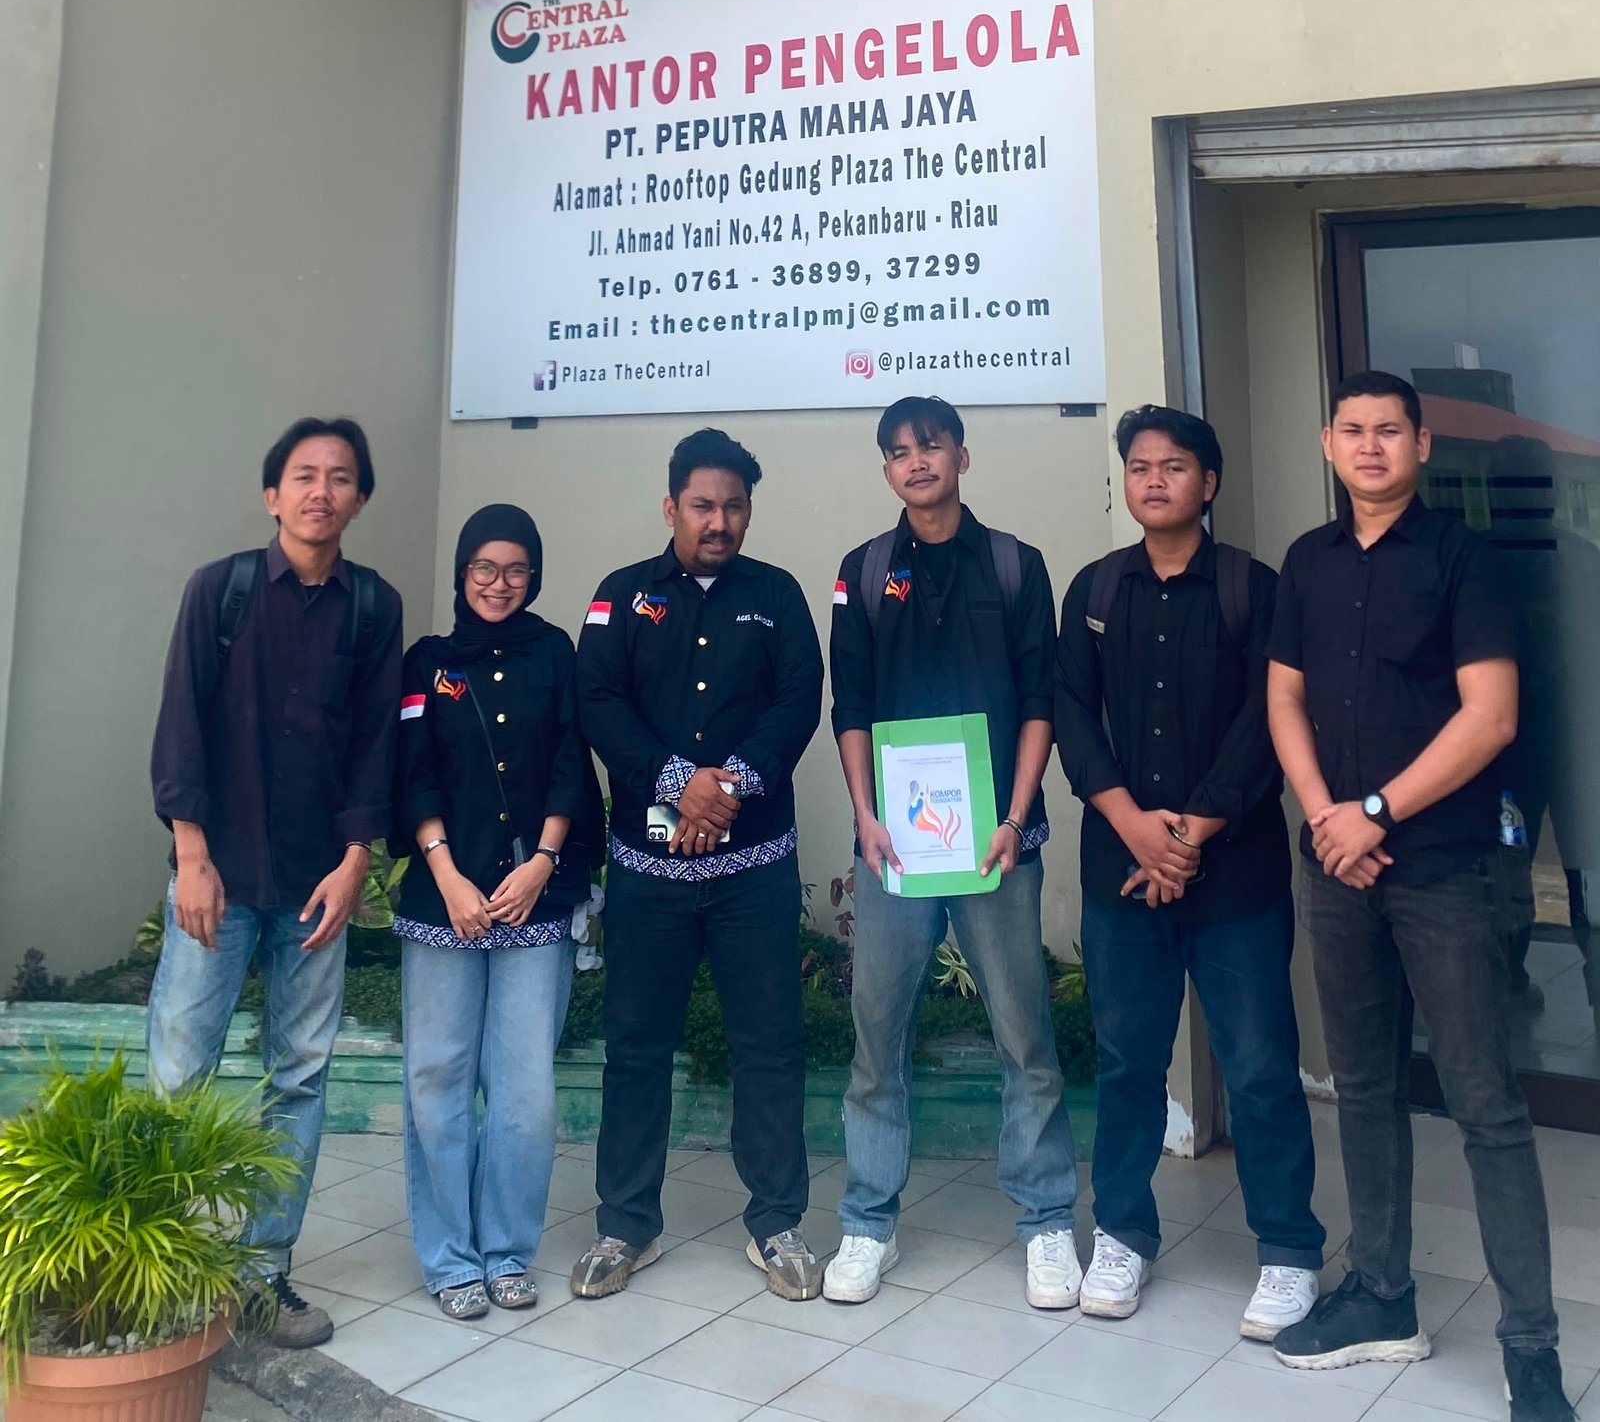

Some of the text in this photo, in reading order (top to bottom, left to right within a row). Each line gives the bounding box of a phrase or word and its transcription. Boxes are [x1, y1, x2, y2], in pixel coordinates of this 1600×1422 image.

[547, 24, 626, 53] PLAZA
[526, 3, 1081, 121] KANTOR PENGELOLA
[605, 89, 977, 159] PT. PEPUTRA MAHA JAYA
[553, 177, 622, 212] Alamat
[645, 168, 730, 204] Rooftop
[739, 160, 821, 196] Gedung
[831, 153, 893, 187] Plaza
[903, 147, 944, 181] The
[954, 135, 1047, 176] Central
[615, 225, 674, 256] Ahmad
[682, 219, 721, 250] Yani
[729, 214, 783, 246] No.42
[792, 213, 810, 247] A,
[819, 206, 926, 239] Pekanbaru
[950, 199, 998, 229] Riau
[599, 276, 661, 300] Telp.
[674, 268, 739, 293] 0761
[771, 259, 871, 287] 36899,
[886, 252, 981, 279] 37299
[548, 317, 619, 341] Email
[650, 297, 1051, 336] thecentralpmj@gmail.com
[562, 359, 711, 383] Plaza TheCentral
[878, 346, 1071, 375] @plazathecentral
[930, 789, 962, 798] KOMPOR
